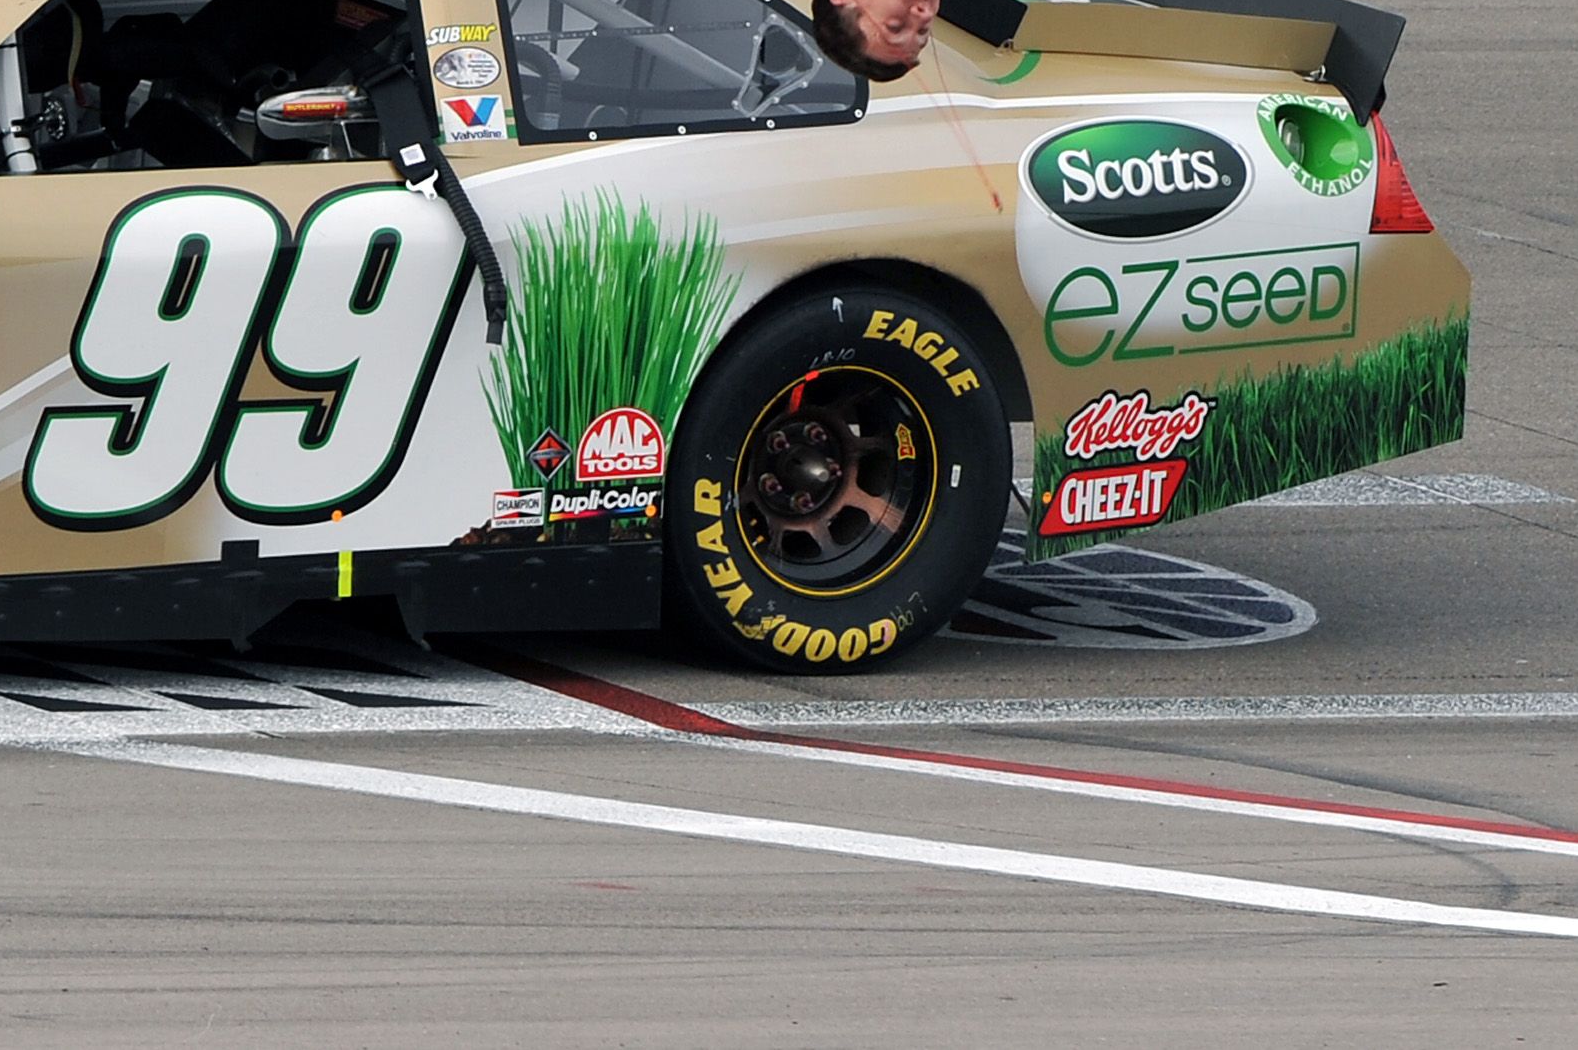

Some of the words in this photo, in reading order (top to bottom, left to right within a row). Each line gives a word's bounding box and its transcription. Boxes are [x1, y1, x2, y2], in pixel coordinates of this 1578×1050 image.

[426, 23, 497, 46] SUBWAY
[1258, 93, 1348, 122] AMERICAN
[451, 129, 502, 141] Valvoline
[1057, 146, 1219, 205] Scotts
[1287, 158, 1373, 196] ETHANOL
[21, 182, 480, 534] 99
[863, 310, 981, 397] EAGLE
[583, 415, 659, 460] MAC
[1067, 396, 1209, 458] Kellogg's
[582, 457, 658, 473] TOOLS
[496, 497, 540, 511] CHAMPION
[549, 486, 658, 515] Dupli-Color
[1059, 469, 1169, 526] CHEEZ-IT
